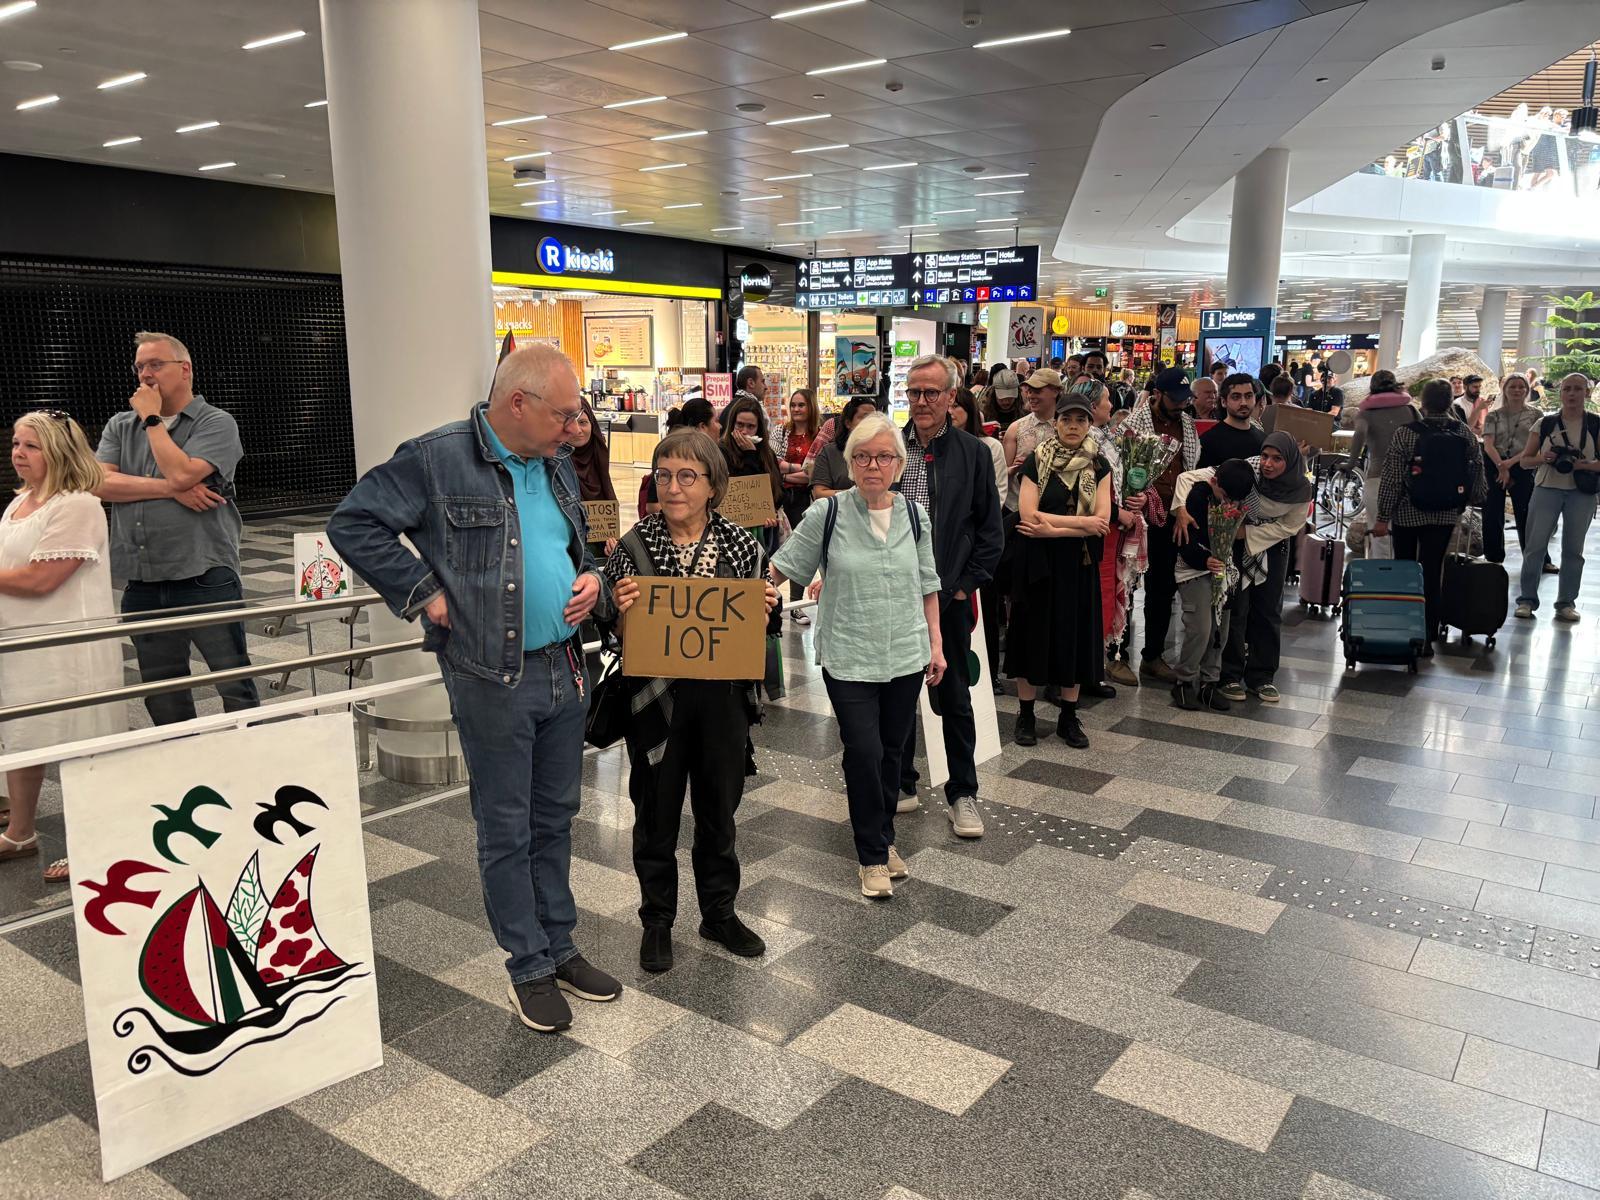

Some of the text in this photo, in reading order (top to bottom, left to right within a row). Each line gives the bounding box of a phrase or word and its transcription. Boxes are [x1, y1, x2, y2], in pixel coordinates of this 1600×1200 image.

[545, 245, 614, 272] R kioski
[938, 252, 981, 262] Railway Station
[999, 251, 1015, 259] Hotel
[867, 259, 878, 267] App
[971, 268, 986, 276] Hotel
[741, 274, 770, 290] Normal
[822, 276, 834, 284] Hotel
[1006, 289, 1014, 297] P4
[1222, 311, 1255, 321] Services
[496, 319, 503, 330] &
[706, 375, 730, 383] Prepaid
[706, 384, 730, 397] SIM
[710, 398, 729, 407] ards
[730, 480, 761, 493] ESTINIAN
[586, 503, 617, 516] ITOS!
[720, 504, 741, 514] TLESS
[647, 584, 746, 623] FUCK
[664, 624, 729, 661] IOF
